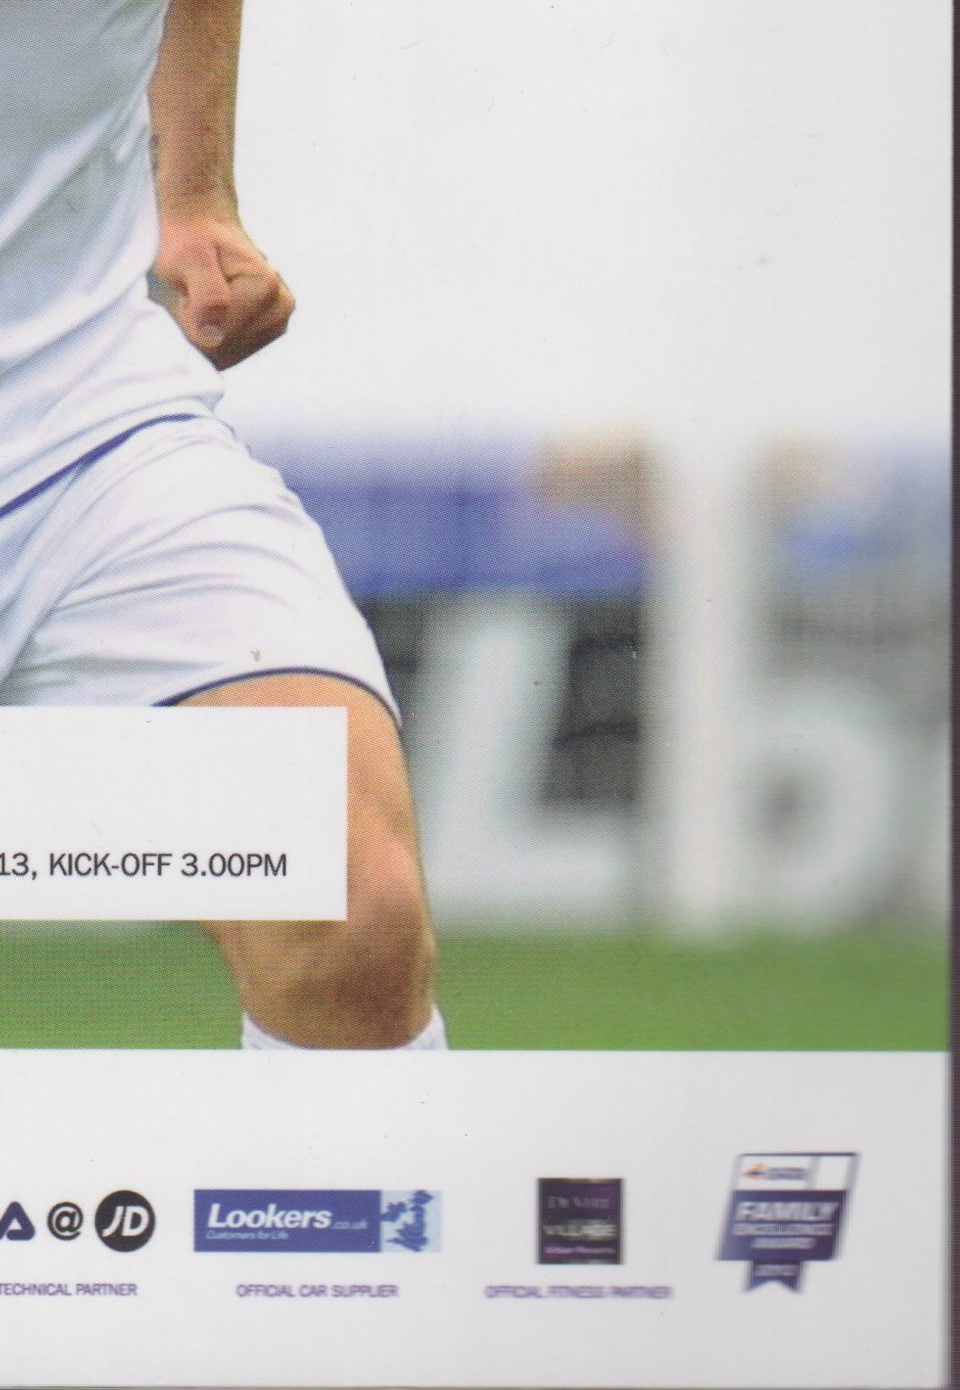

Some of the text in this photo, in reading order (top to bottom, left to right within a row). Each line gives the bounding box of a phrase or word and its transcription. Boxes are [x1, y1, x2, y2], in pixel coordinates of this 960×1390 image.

[50, 852, 173, 877] KICK-OFF
[181, 853, 287, 877] 3.00PM
[101, 1204, 147, 1238] JD
[206, 1230, 289, 1240] Customers for Life
[77, 1283, 137, 1296] PARTNER
[236, 1284, 398, 1298] OFFICIAL CAR SUPPLIER
